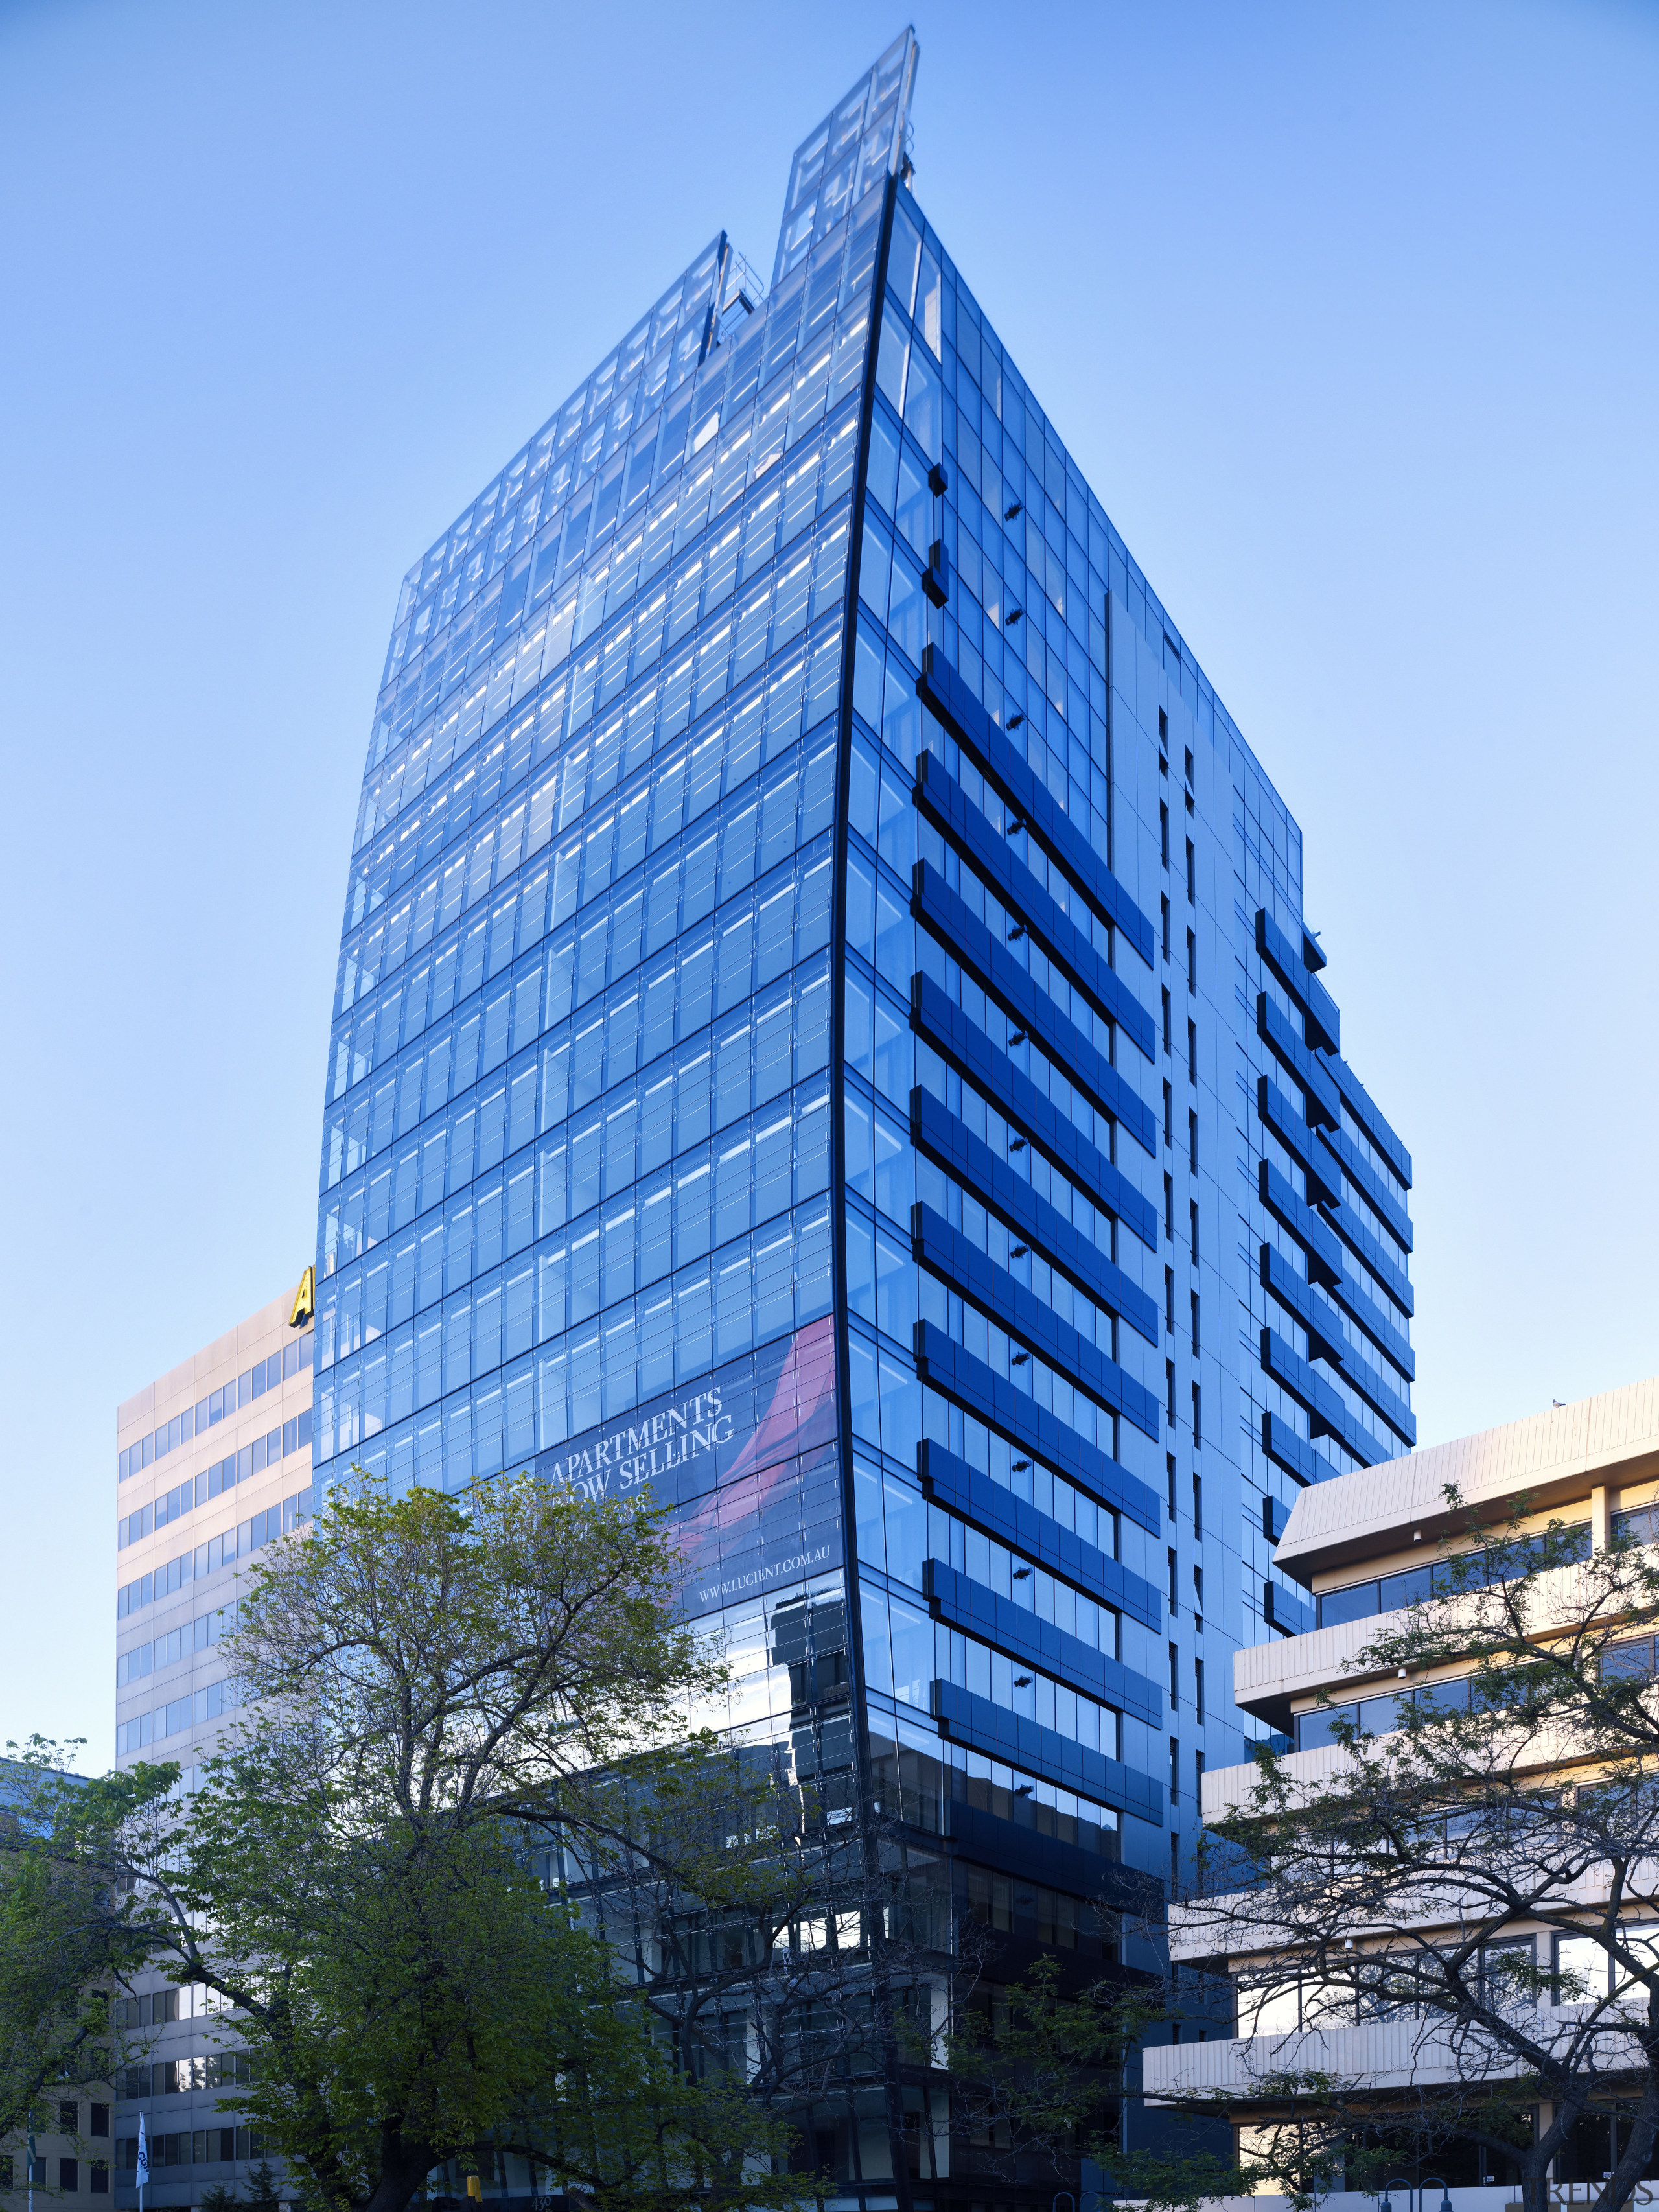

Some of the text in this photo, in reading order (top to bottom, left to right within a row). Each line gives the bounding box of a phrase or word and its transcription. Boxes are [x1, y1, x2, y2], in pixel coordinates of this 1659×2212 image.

[288, 1264, 316, 1328] A
[551, 1386, 723, 1491] APARTMENTS
[620, 1415, 735, 1490] SELLING
[699, 1544, 830, 1603] WWW.LUCIENT.COM.AU
[531, 2196, 552, 2211] 430
